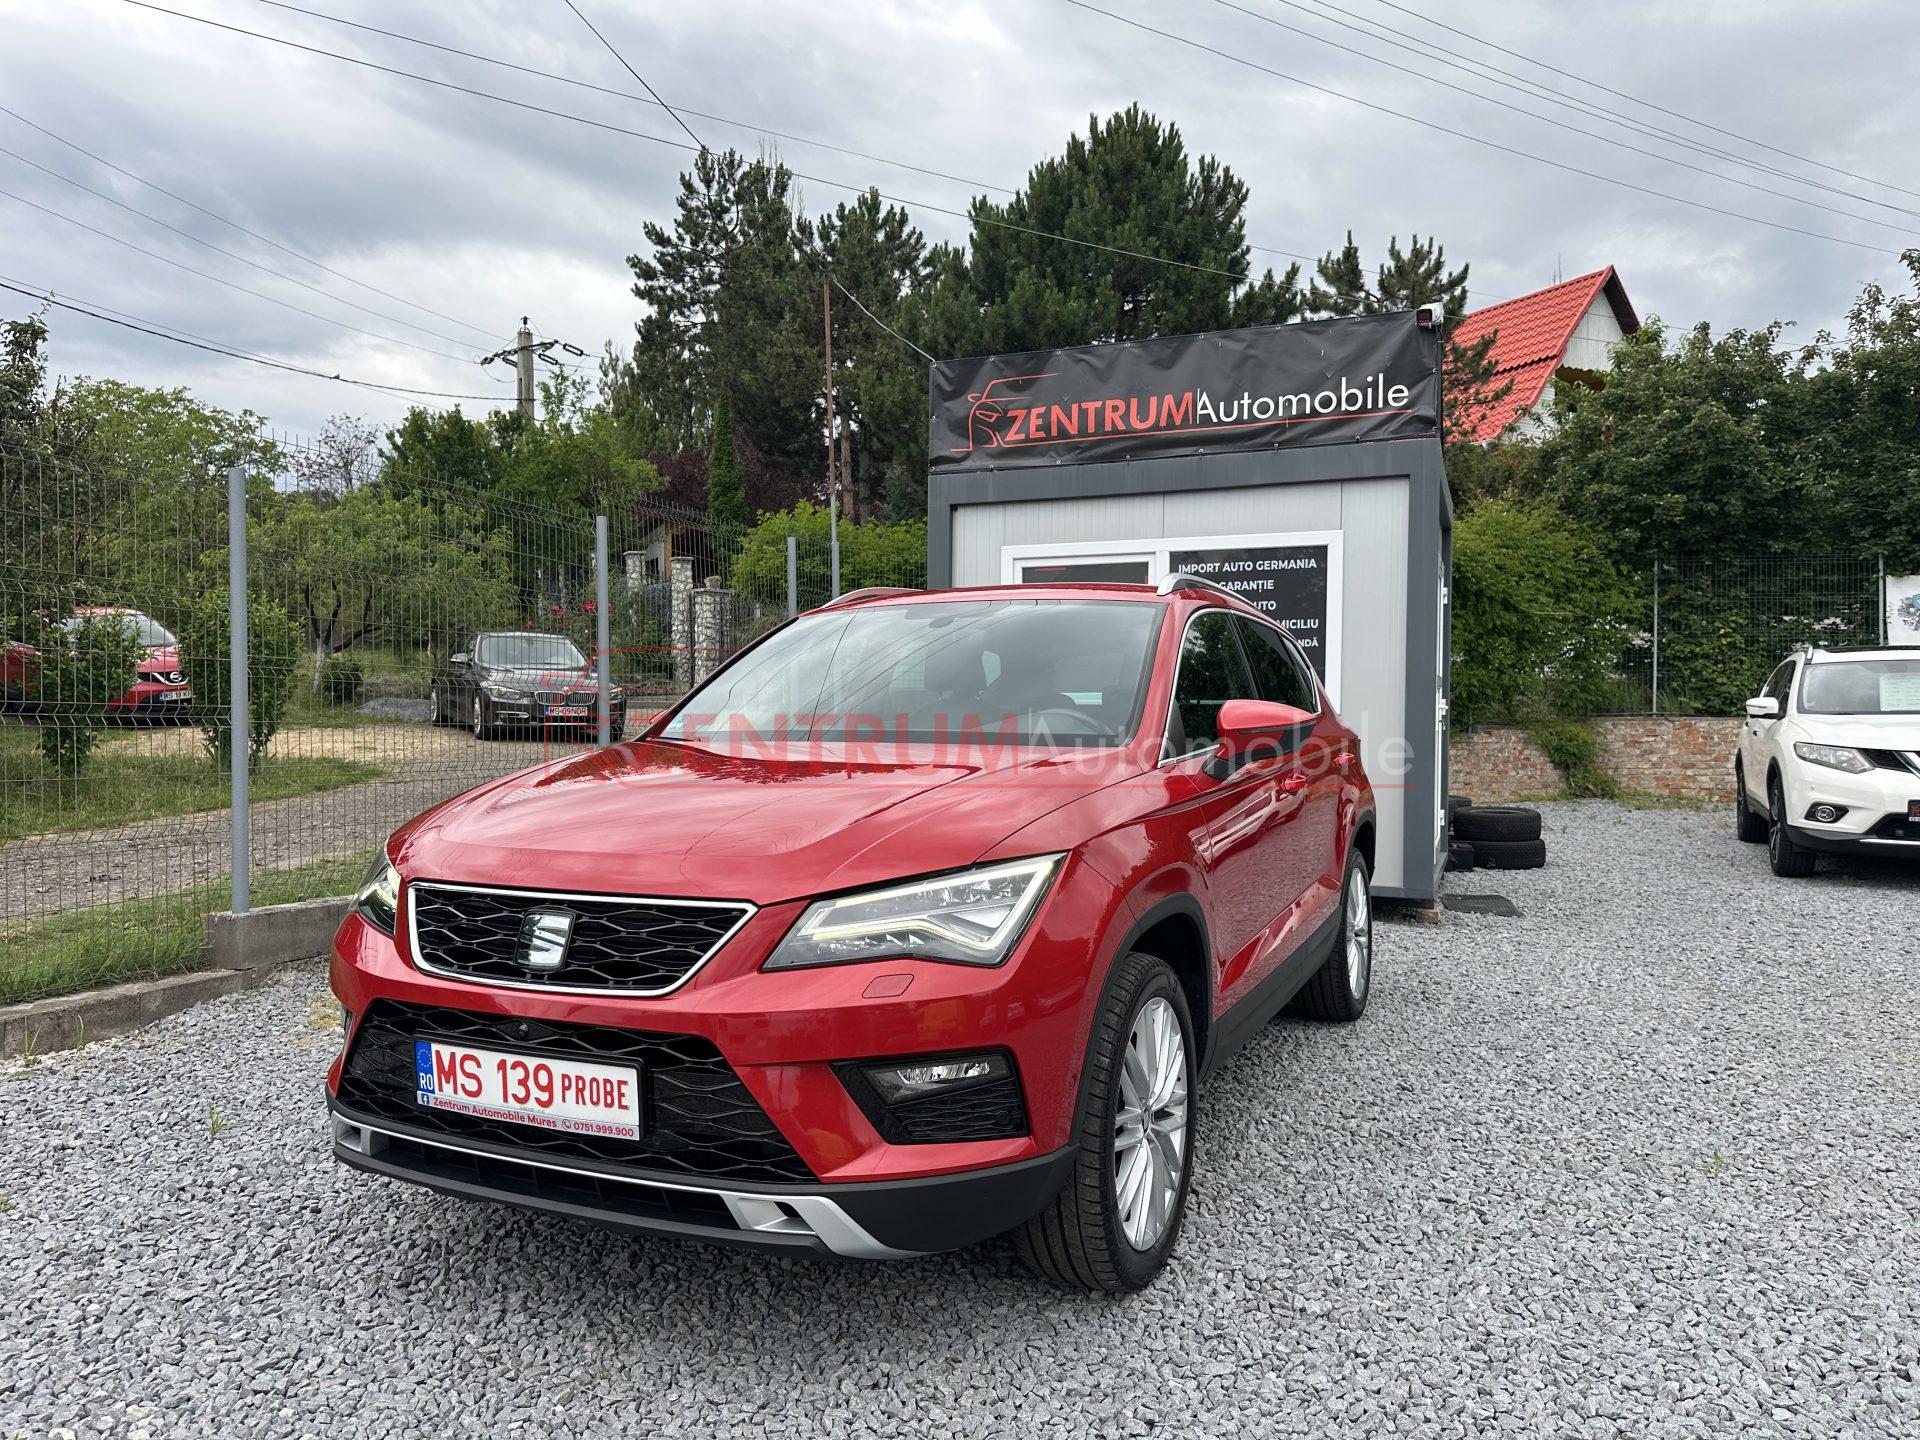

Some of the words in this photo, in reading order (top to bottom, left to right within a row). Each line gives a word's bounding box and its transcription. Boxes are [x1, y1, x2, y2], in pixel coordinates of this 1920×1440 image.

[1005, 391, 1194, 441] ZENTRUM
[1196, 373, 1410, 424] Automobile
[1178, 562, 1220, 574] IMPORT
[1222, 561, 1253, 572] AUTO
[1256, 558, 1317, 571] GERMANIA
[419, 1072, 434, 1090] RO
[434, 1049, 483, 1098] MS
[496, 1058, 554, 1109] 139
[561, 1073, 630, 1111] PROBE
[433, 1096, 470, 1113] Zentrum
[472, 1105, 526, 1123] Automobile
[527, 1114, 557, 1128] Mures
[573, 1121, 634, 1137] 0751.999.900
